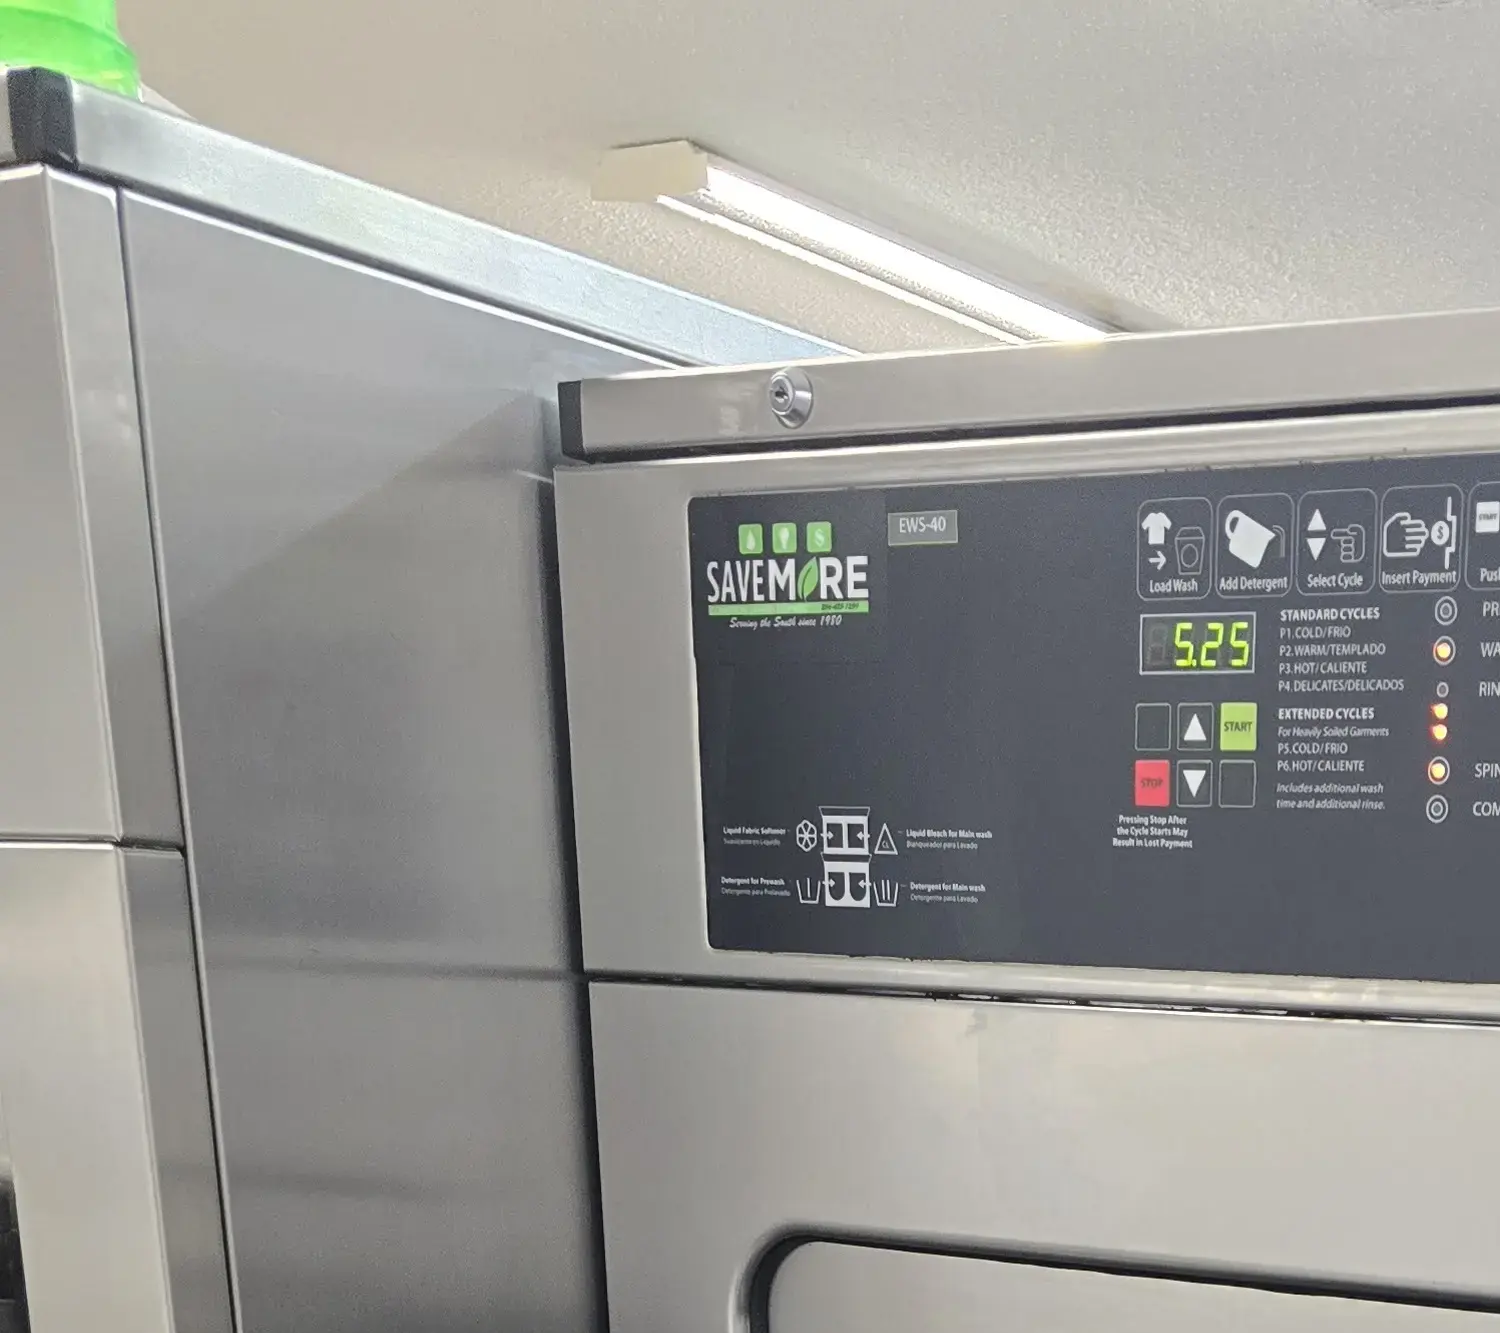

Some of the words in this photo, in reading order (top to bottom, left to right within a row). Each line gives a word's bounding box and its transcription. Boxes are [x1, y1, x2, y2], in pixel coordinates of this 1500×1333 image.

[899, 517, 946, 533] EWS-40
[1307, 574, 1336, 588] Select
[1338, 572, 1364, 590] Cycle
[1382, 571, 1410, 585] Insert
[1412, 570, 1457, 586] Payment
[1150, 579, 1172, 593] Load
[1173, 578, 1198, 592] Wash
[1219, 577, 1240, 590] Add
[1242, 576, 1288, 594] Detergent
[820, 614, 842, 626] 1980
[1280, 608, 1338, 622] STANDARD
[1340, 607, 1380, 620] CYCLES
[1174, 621, 1249, 667] 5.25
[1278, 708, 1334, 720] EXTENDED
[1335, 707, 1375, 720] CYCLES
[1223, 721, 1252, 732] START
[1277, 726, 1291, 737] For
[1292, 726, 1322, 739] Heavily
[1322, 726, 1348, 737] Soiled
[1350, 727, 1390, 737] Garments
[1140, 778, 1164, 788] STOP
[1276, 783, 1313, 793] Includes
[1314, 783, 1360, 793] additional
[1360, 783, 1384, 793] wash
[1276, 799, 1296, 809] time
[1296, 799, 1315, 809] and
[1315, 799, 1361, 809] additional
[1361, 799, 1386, 810] rinse.
[1118, 814, 1149, 826] Pressing
[1149, 814, 1167, 826] Stop
[1168, 815, 1187, 825] After
[906, 829, 926, 839] Liquid
[948, 829, 958, 838] for
[1116, 826, 1129, 836] the
[1130, 826, 1148, 837] Cycle
[1149, 826, 1171, 836] Starts
[1172, 827, 1189, 838] May
[1112, 837, 1135, 847] Result
[1135, 838, 1143, 847] in
[1144, 838, 1160, 847] Lost
[1160, 838, 1193, 850] Payment
[910, 881, 941, 892] Detergent
[942, 882, 952, 891] for
[952, 883, 968, 892] Main
[969, 884, 986, 892] wash
